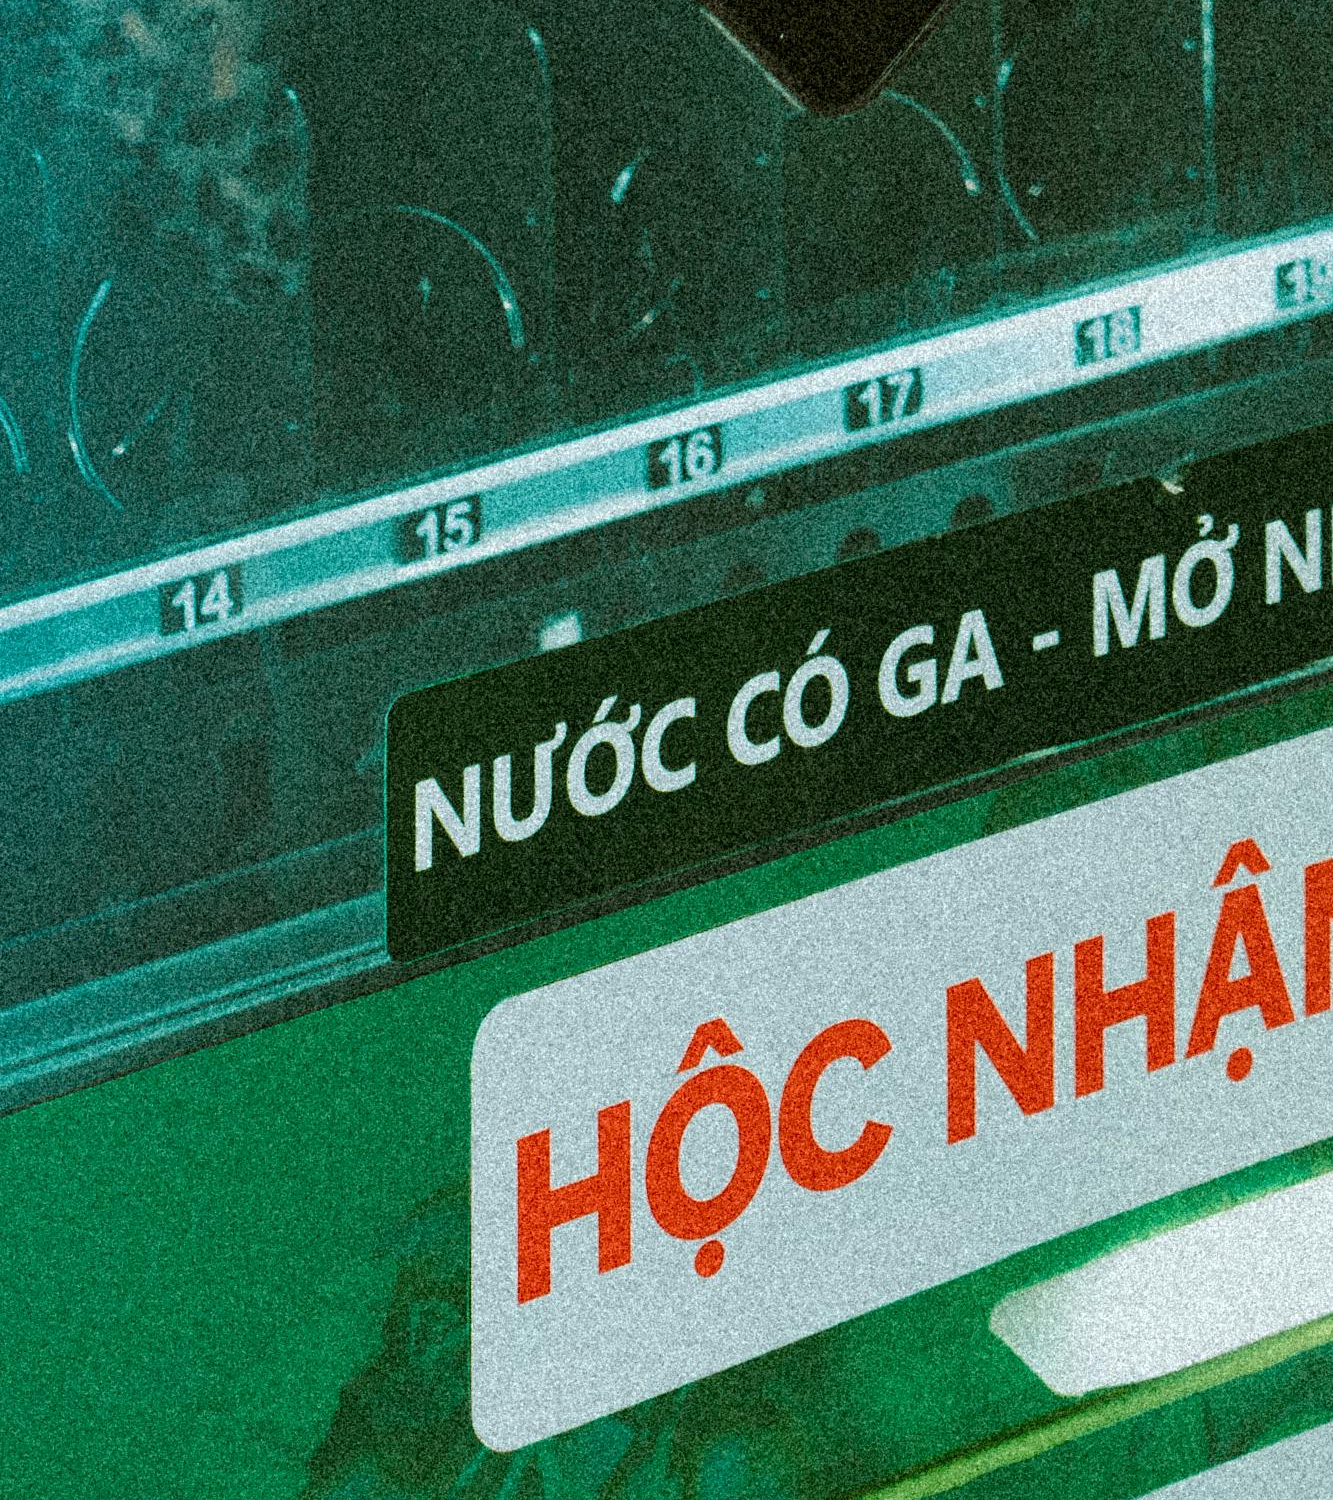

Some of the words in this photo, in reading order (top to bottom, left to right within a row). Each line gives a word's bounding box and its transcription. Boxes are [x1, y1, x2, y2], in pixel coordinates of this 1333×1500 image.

[169, 569, 231, 632] 14
[416, 497, 473, 561] 15
[658, 428, 717, 488] 16
[858, 369, 916, 430] 17
[1084, 306, 1137, 364] 18
[413, 696, 697, 872] NƯỚC
[727, 631, 850, 767] CÓ
[878, 609, 1004, 719] GA
[1031, 628, 1060, 652] -
[1091, 513, 1240, 657] MỞ
[516, 1019, 893, 1304] HỘC
